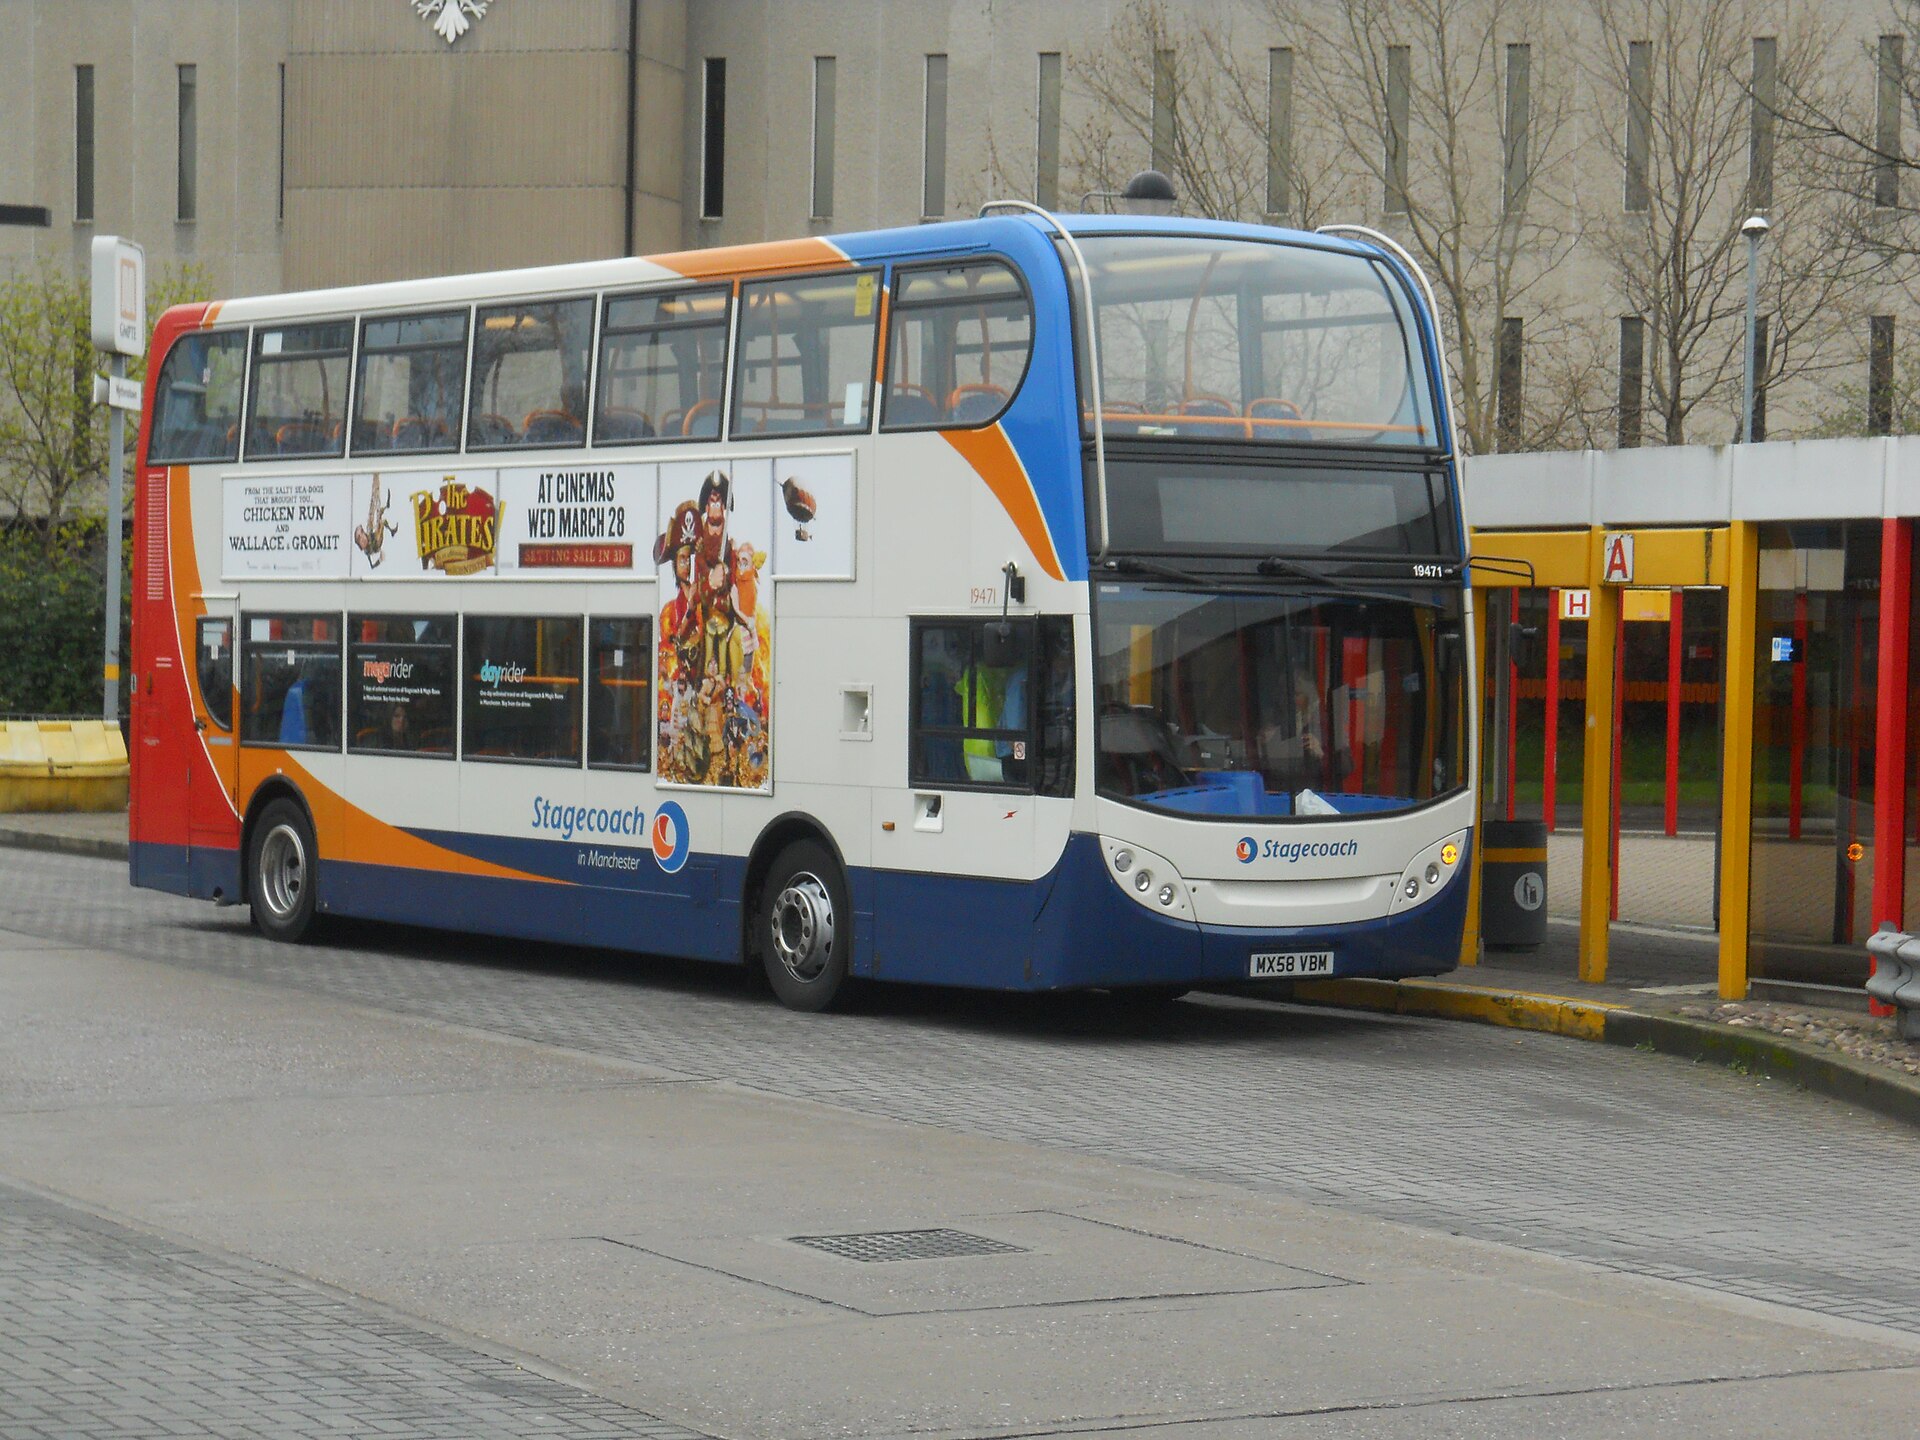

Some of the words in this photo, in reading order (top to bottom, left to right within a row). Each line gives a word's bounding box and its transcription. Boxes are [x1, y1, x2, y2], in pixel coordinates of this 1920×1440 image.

[244, 487, 260, 495] FROM
[276, 486, 293, 495] SALTY
[442, 475, 468, 510] The
[538, 473, 553, 503] AT
[556, 471, 615, 503] CINEMAS
[254, 496, 269, 505] THAT
[270, 495, 297, 504] BROUGHT
[243, 506, 295, 522] CHICKEN
[299, 505, 325, 521] RUN
[528, 508, 555, 538] WED
[559, 506, 605, 538] MARCH
[608, 506, 625, 537] 28
[275, 524, 290, 533] AND
[229, 536, 285, 551] WALLACE
[292, 535, 340, 550] GROMIT
[524, 549, 570, 563] SETTING
[573, 549, 596, 563] SAIL
[598, 549, 610, 563] IN
[613, 549, 626, 563] 3D
[1606, 538, 1628, 579] A
[1412, 564, 1443, 578] 19471
[970, 587, 996, 604] 19471
[1569, 593, 1587, 615] H
[363, 657, 414, 684] megarider
[480, 659, 527, 688] dayrider
[532, 795, 645, 840] Stagecoach
[577, 850, 586, 866] in
[587, 850, 641, 870] Manchester
[1262, 838, 1358, 863] Stagecoach
[1256, 955, 1295, 974] MX58
[1300, 954, 1328, 972] VBM
